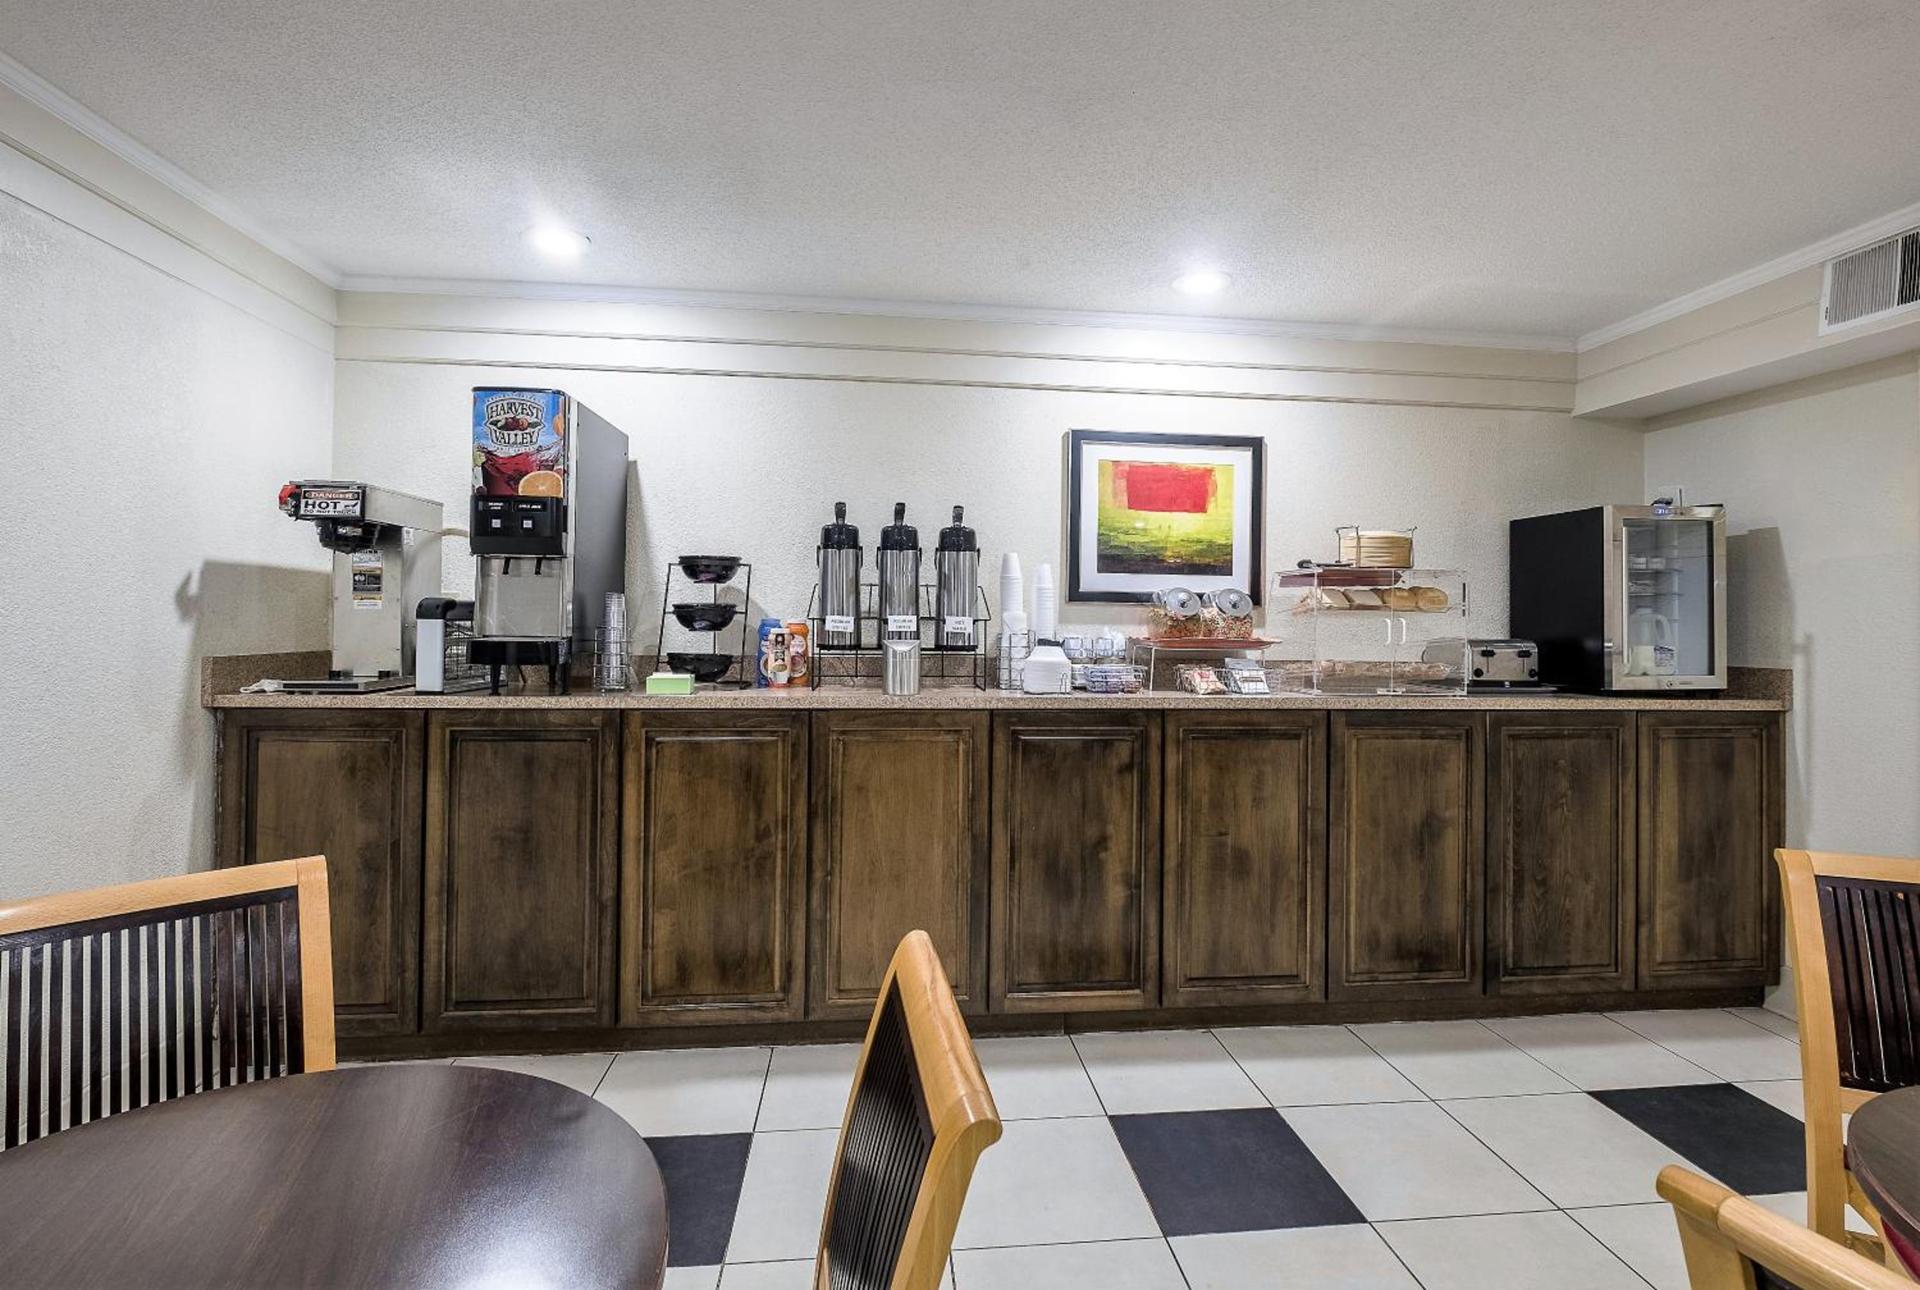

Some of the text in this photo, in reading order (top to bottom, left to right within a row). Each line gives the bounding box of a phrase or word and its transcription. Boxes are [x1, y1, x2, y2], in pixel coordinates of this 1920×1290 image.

[489, 401, 541, 419] HARVEST
[493, 430, 536, 445] VALLEY
[311, 491, 353, 500] DANGER
[304, 500, 341, 510] HOT
